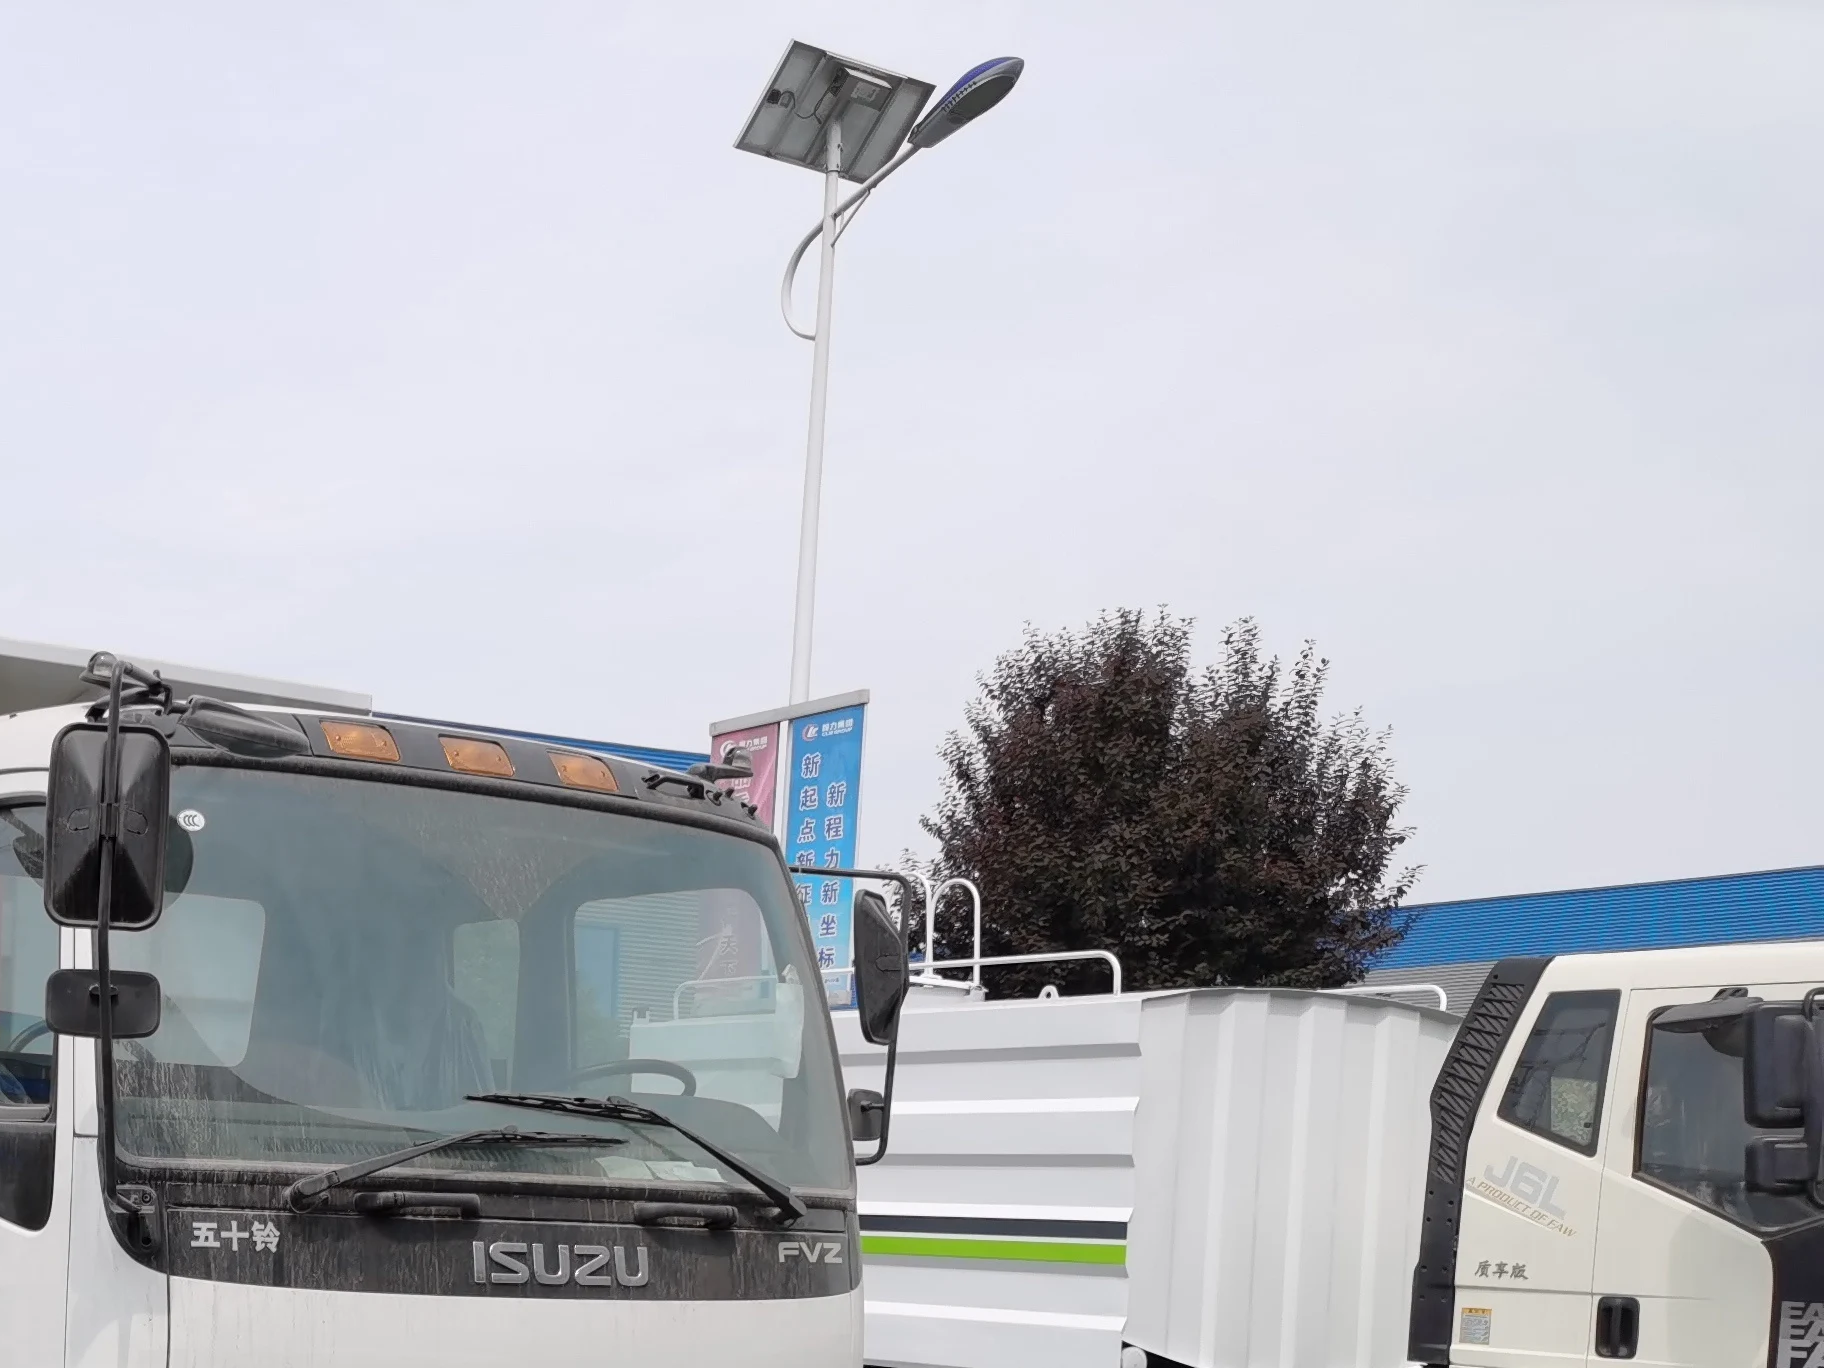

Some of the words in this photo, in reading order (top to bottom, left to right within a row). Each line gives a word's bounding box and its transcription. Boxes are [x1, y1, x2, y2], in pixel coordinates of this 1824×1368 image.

[795, 752, 821, 915] 新起点新征
[818, 781, 847, 969] 新程力新坐标
[1466, 1176, 1476, 1186] A
[1476, 1181, 1532, 1214] PRODUCT
[1530, 1209, 1547, 1223] OF
[1547, 1218, 1578, 1238] FAW
[1483, 1155, 1567, 1221] J6L
[190, 1220, 281, 1254] 五十铃
[472, 1241, 649, 1287] ISUZU
[777, 1241, 844, 1264] FVZ
[1474, 1260, 1529, 1281] 质享版
